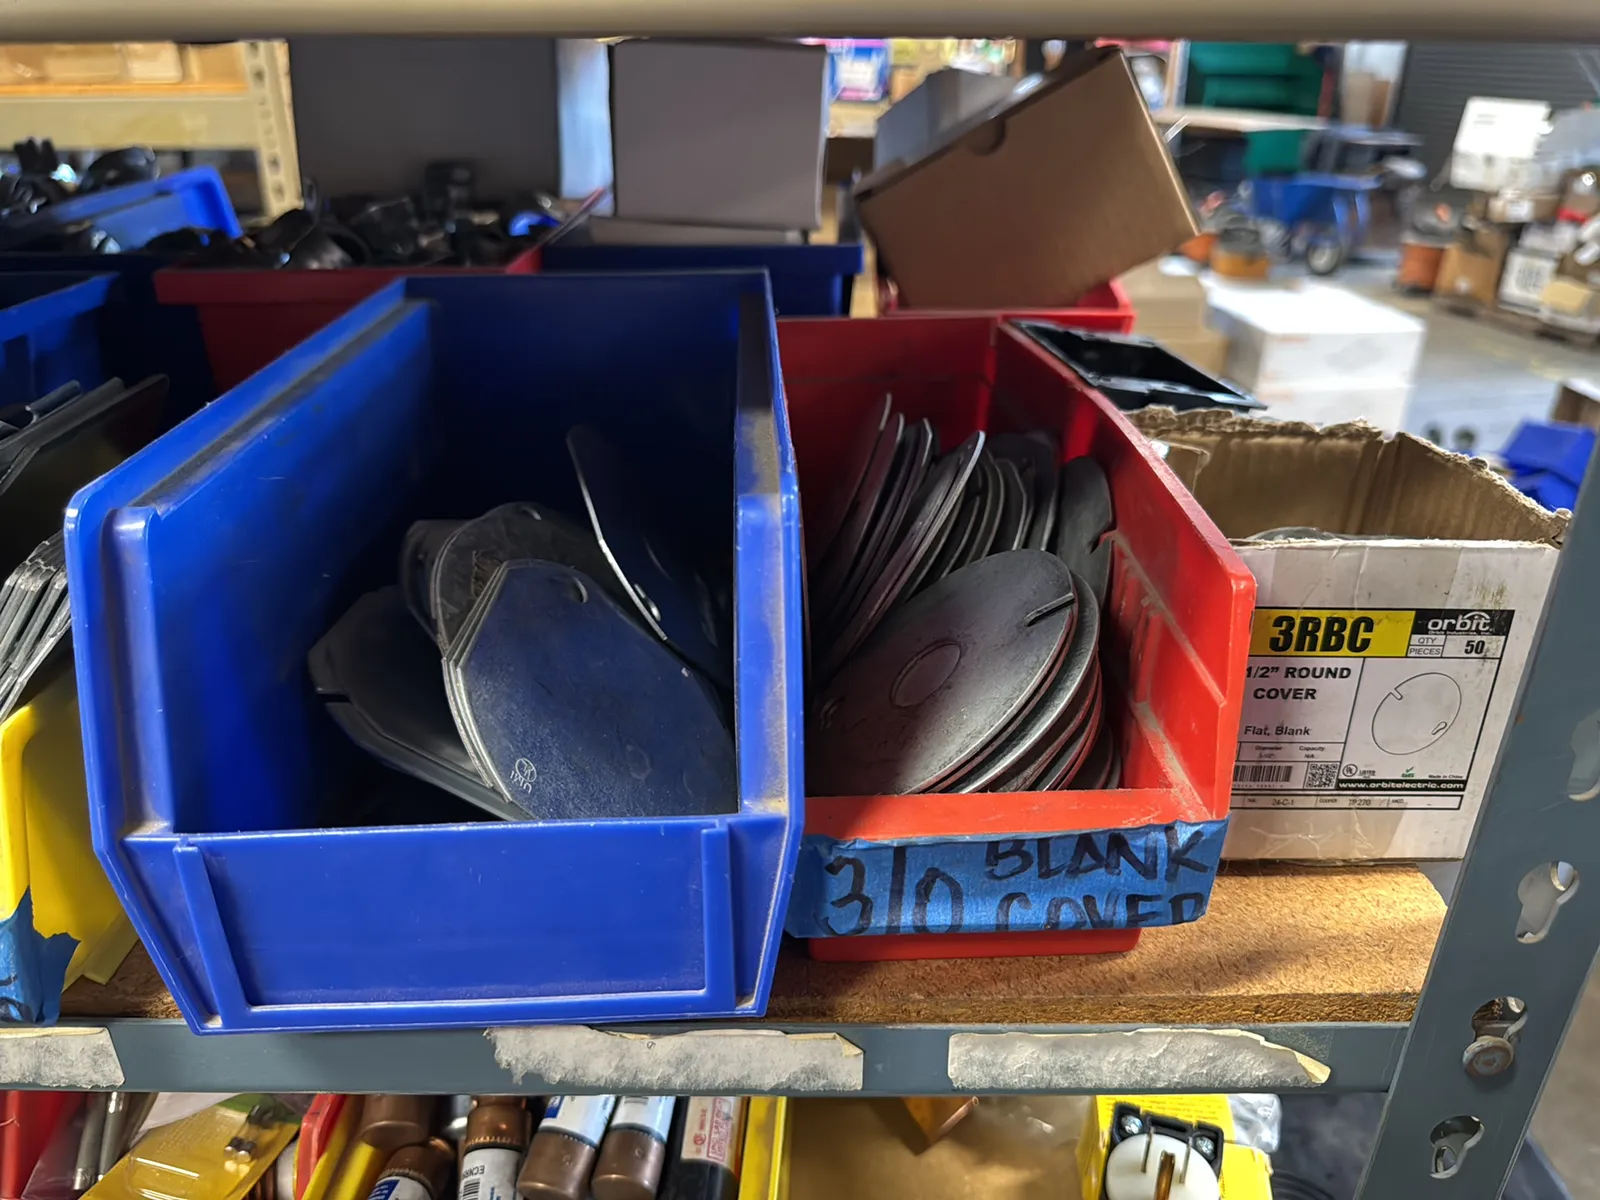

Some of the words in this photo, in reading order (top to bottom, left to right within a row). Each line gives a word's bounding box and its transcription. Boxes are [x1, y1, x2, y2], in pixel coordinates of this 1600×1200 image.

[1427, 612, 1491, 631] orbit
[1269, 615, 1374, 653] 3RBC
[1409, 647, 1441, 655] PIECES
[1464, 640, 1485, 654] 50
[1284, 667, 1351, 679] ROUND
[1253, 688, 1317, 700] COVER
[1244, 726, 1270, 736] Flat,
[1275, 726, 1310, 736] Blank
[1338, 780, 1464, 789] www.orbitelectric.com
[986, 826, 1212, 882] BLANK
